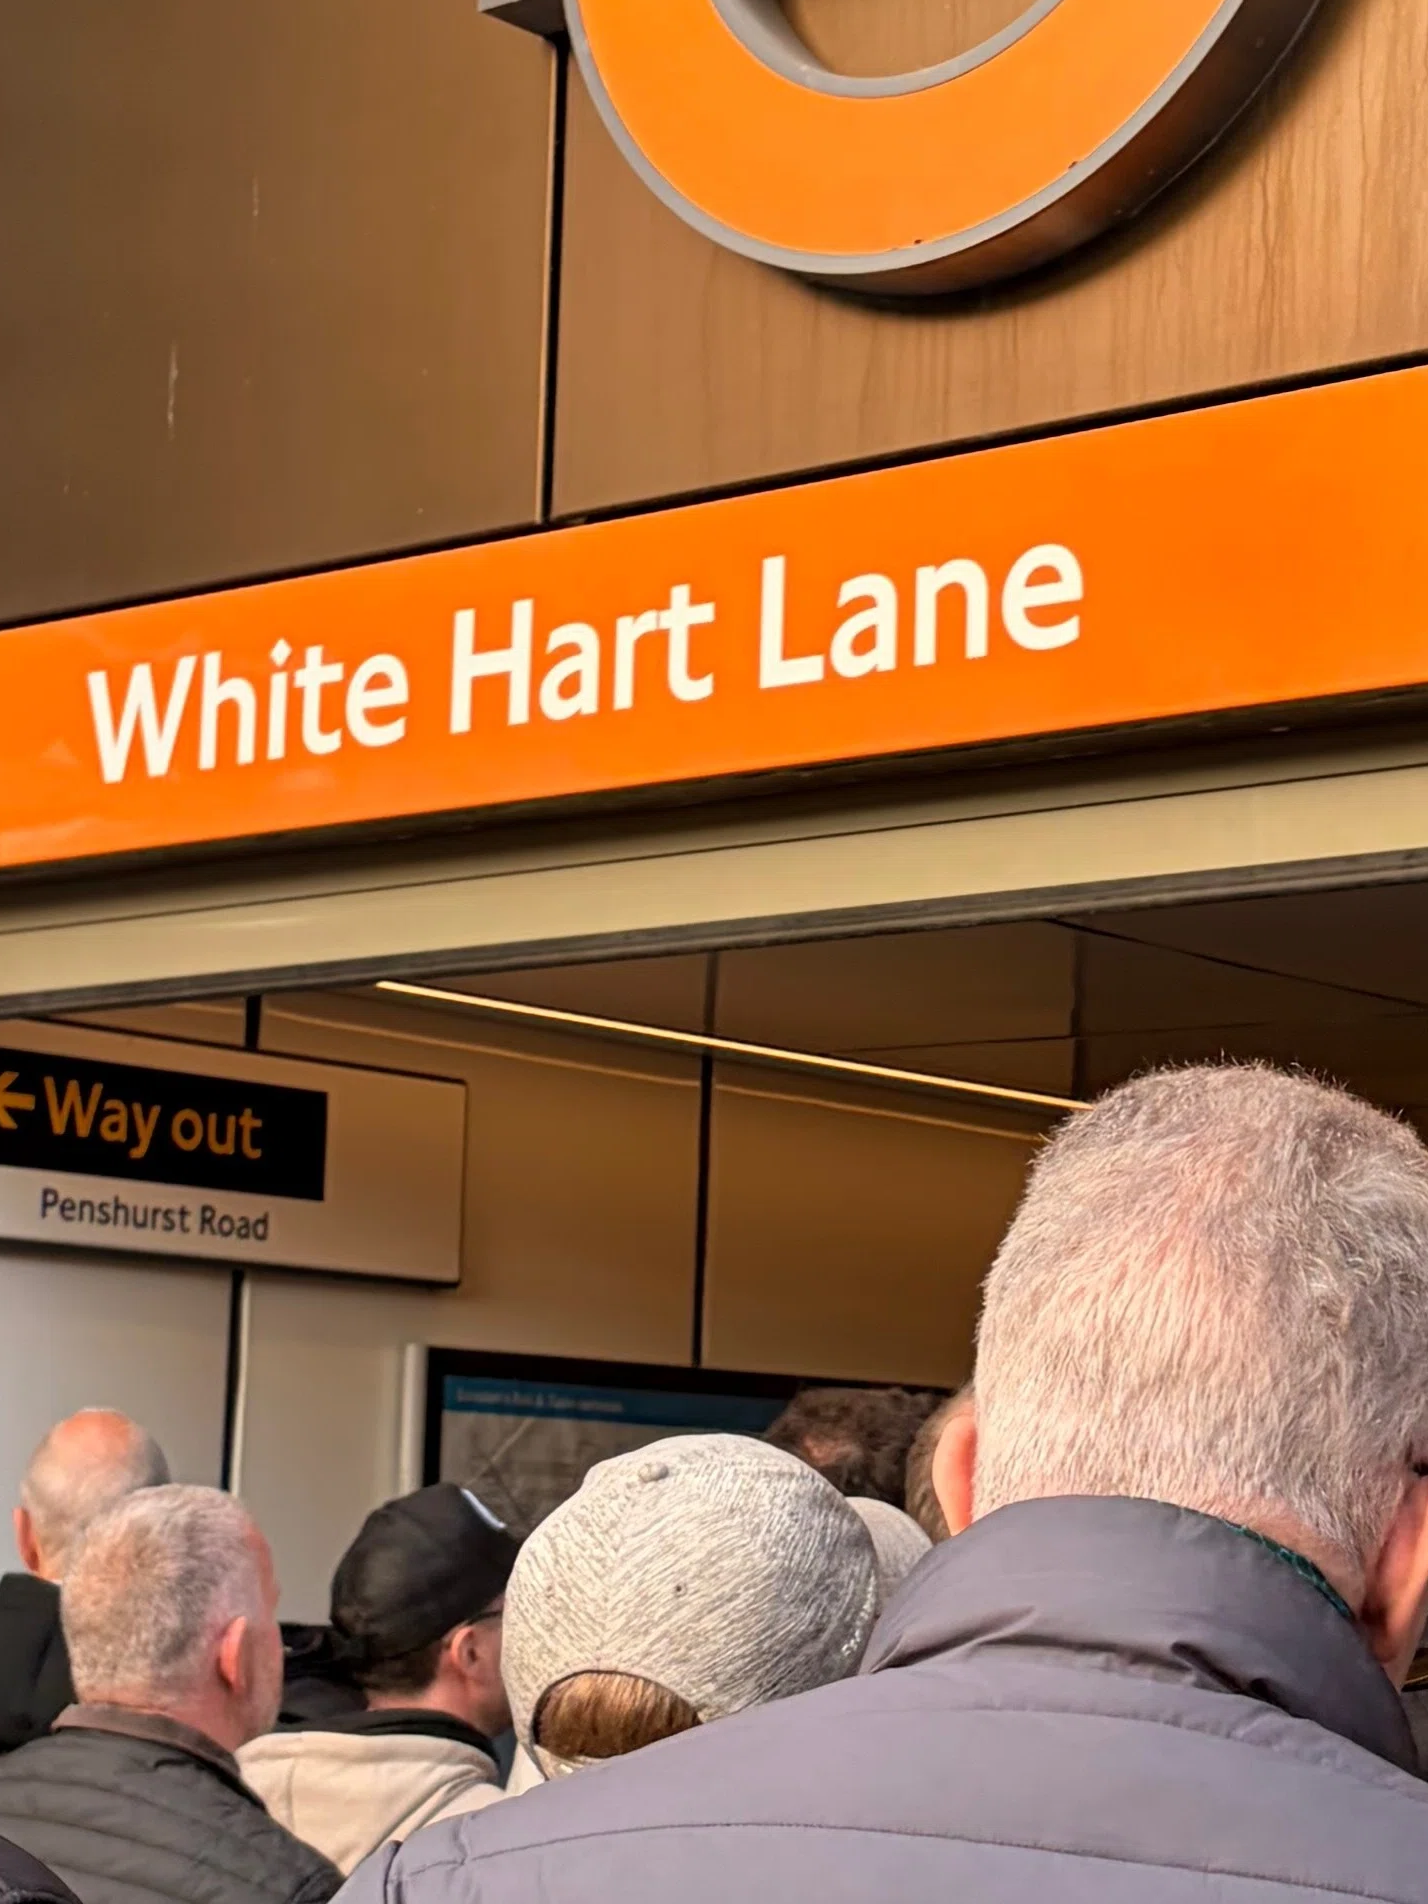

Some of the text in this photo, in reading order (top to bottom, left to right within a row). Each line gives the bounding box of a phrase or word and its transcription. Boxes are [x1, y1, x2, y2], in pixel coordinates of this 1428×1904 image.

[85, 542, 1085, 785] White Hart Lane
[43, 1075, 263, 1159] Way out
[40, 1187, 270, 1242] Penshurst Road
